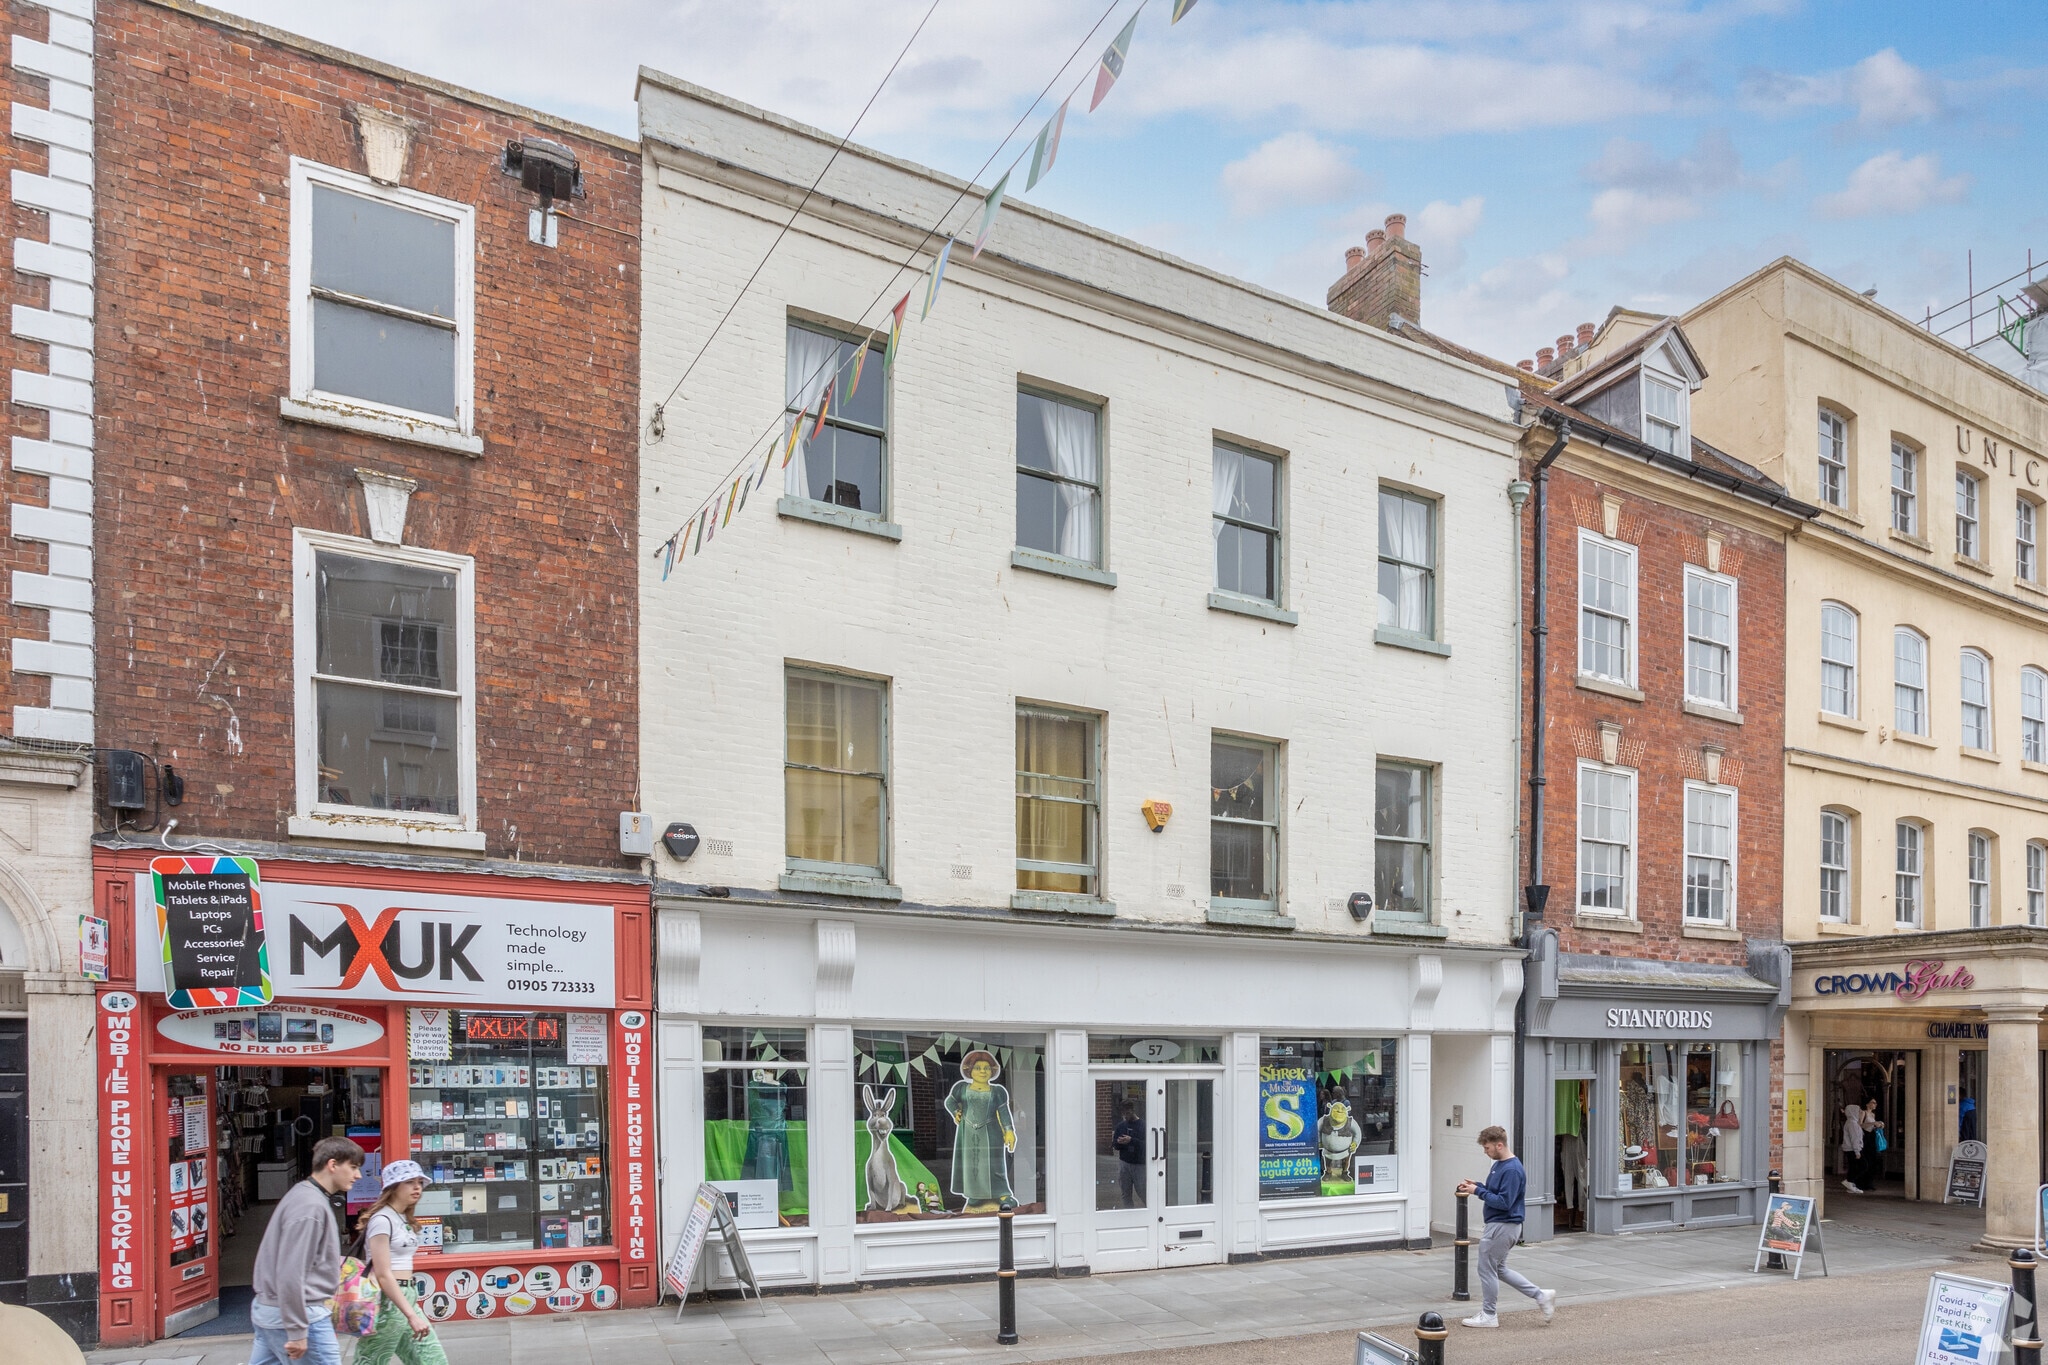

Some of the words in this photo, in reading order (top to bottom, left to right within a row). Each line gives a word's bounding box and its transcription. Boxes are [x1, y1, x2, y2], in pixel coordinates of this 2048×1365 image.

[1956, 424, 2048, 488] UNIC
[633, 816, 639, 824] 6
[168, 880, 206, 891] Mobile
[208, 880, 246, 891] Phones
[170, 895, 208, 905] Tablets
[210, 896, 219, 904] &
[221, 894, 248, 904] iPads
[189, 911, 232, 921] Laptops
[203, 925, 223, 934] PCs
[506, 923, 587, 943] Technology
[184, 938, 245, 949] Accessories
[288, 902, 486, 992] MXUK
[507, 942, 546, 955] made
[197, 953, 236, 963] Service
[201, 967, 235, 979] Repair
[507, 958, 564, 975] simple...
[507, 979, 548, 993] 01905
[551, 980, 596, 994] 723333
[1815, 971, 1912, 995] CROWN
[1895, 960, 1975, 1002] Gate
[177, 1012, 199, 1021] WE
[204, 1006, 249, 1015] REPAIR
[254, 1004, 306, 1013] BROKEN
[311, 1008, 367, 1025] SCREENS
[1607, 1008, 1713, 1029] STANFORDS
[467, 1019, 528, 1038] MXUK
[1974, 1023, 1988, 1039] W
[108, 1016, 131, 1094] MOBILE
[218, 1042, 241, 1051] NO
[247, 1044, 270, 1053] FIX
[276, 1045, 297, 1053] NO
[302, 1043, 330, 1053] FEE
[1148, 1044, 1163, 1056] 57
[624, 1032, 642, 1098] MOBILE
[110, 1100, 131, 1165] PHONE
[627, 1103, 643, 1158] PHONE
[1260, 1158, 1280, 1169] 2nd
[1282, 1158, 1294, 1168] to
[1296, 1157, 1313, 1168] 6th
[1259, 1167, 1291, 1179] ugust
[1293, 1166, 1319, 1176] 2022
[629, 1162, 645, 1259] REPAIRING
[111, 1171, 133, 1288] UNLOCKING
[1939, 1295, 1978, 1310] Covid-19
[1937, 1305, 1962, 1318] Rapid
[1963, 1311, 1992, 1324] Home
[1935, 1315, 1956, 1327] Test
[1954, 1319, 1973, 1331] Kits
[1928, 1351, 1949, 1362] £1.99
